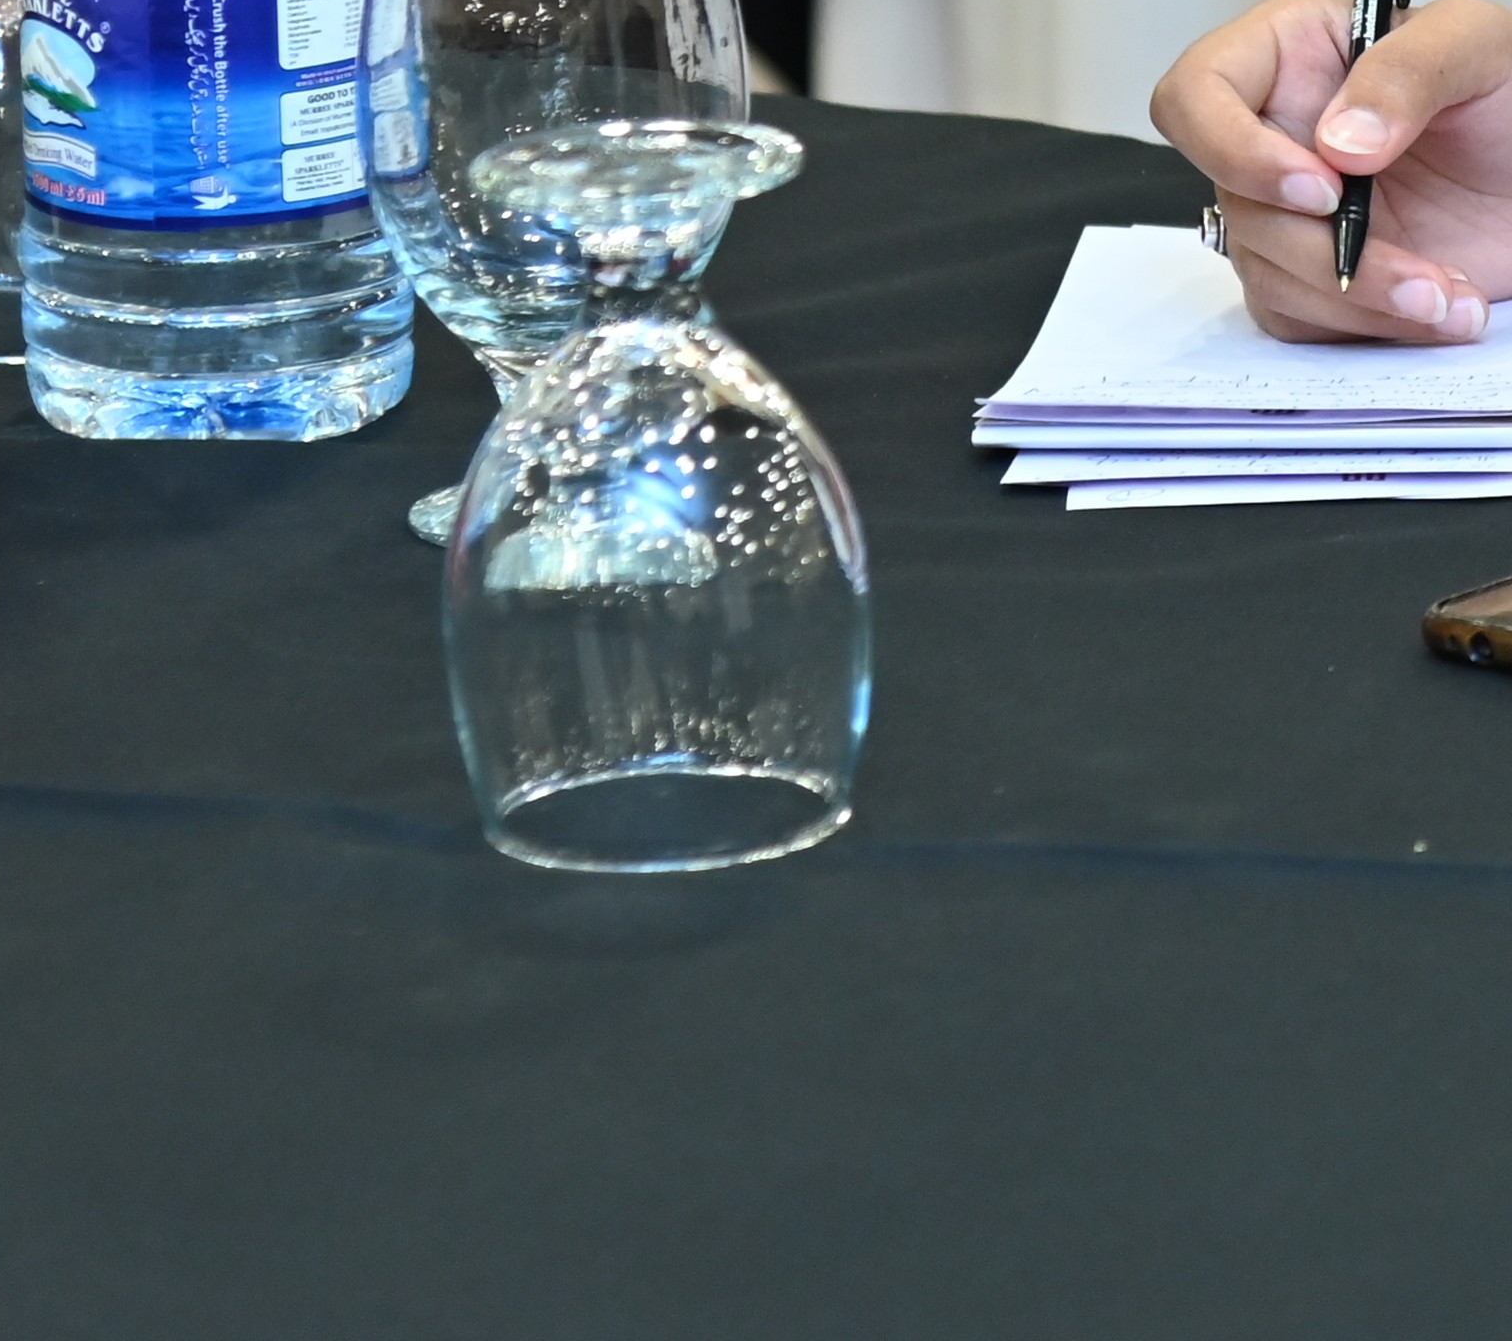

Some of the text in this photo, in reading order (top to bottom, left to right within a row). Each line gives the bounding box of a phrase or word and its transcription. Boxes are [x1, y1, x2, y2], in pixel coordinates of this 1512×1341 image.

[213, 35, 228, 59] the
[215, 60, 230, 102] Bottle
[307, 91, 336, 104] GOOD
[336, 89, 349, 98] TO
[216, 105, 230, 136] after
[64, 148, 93, 170] Water
